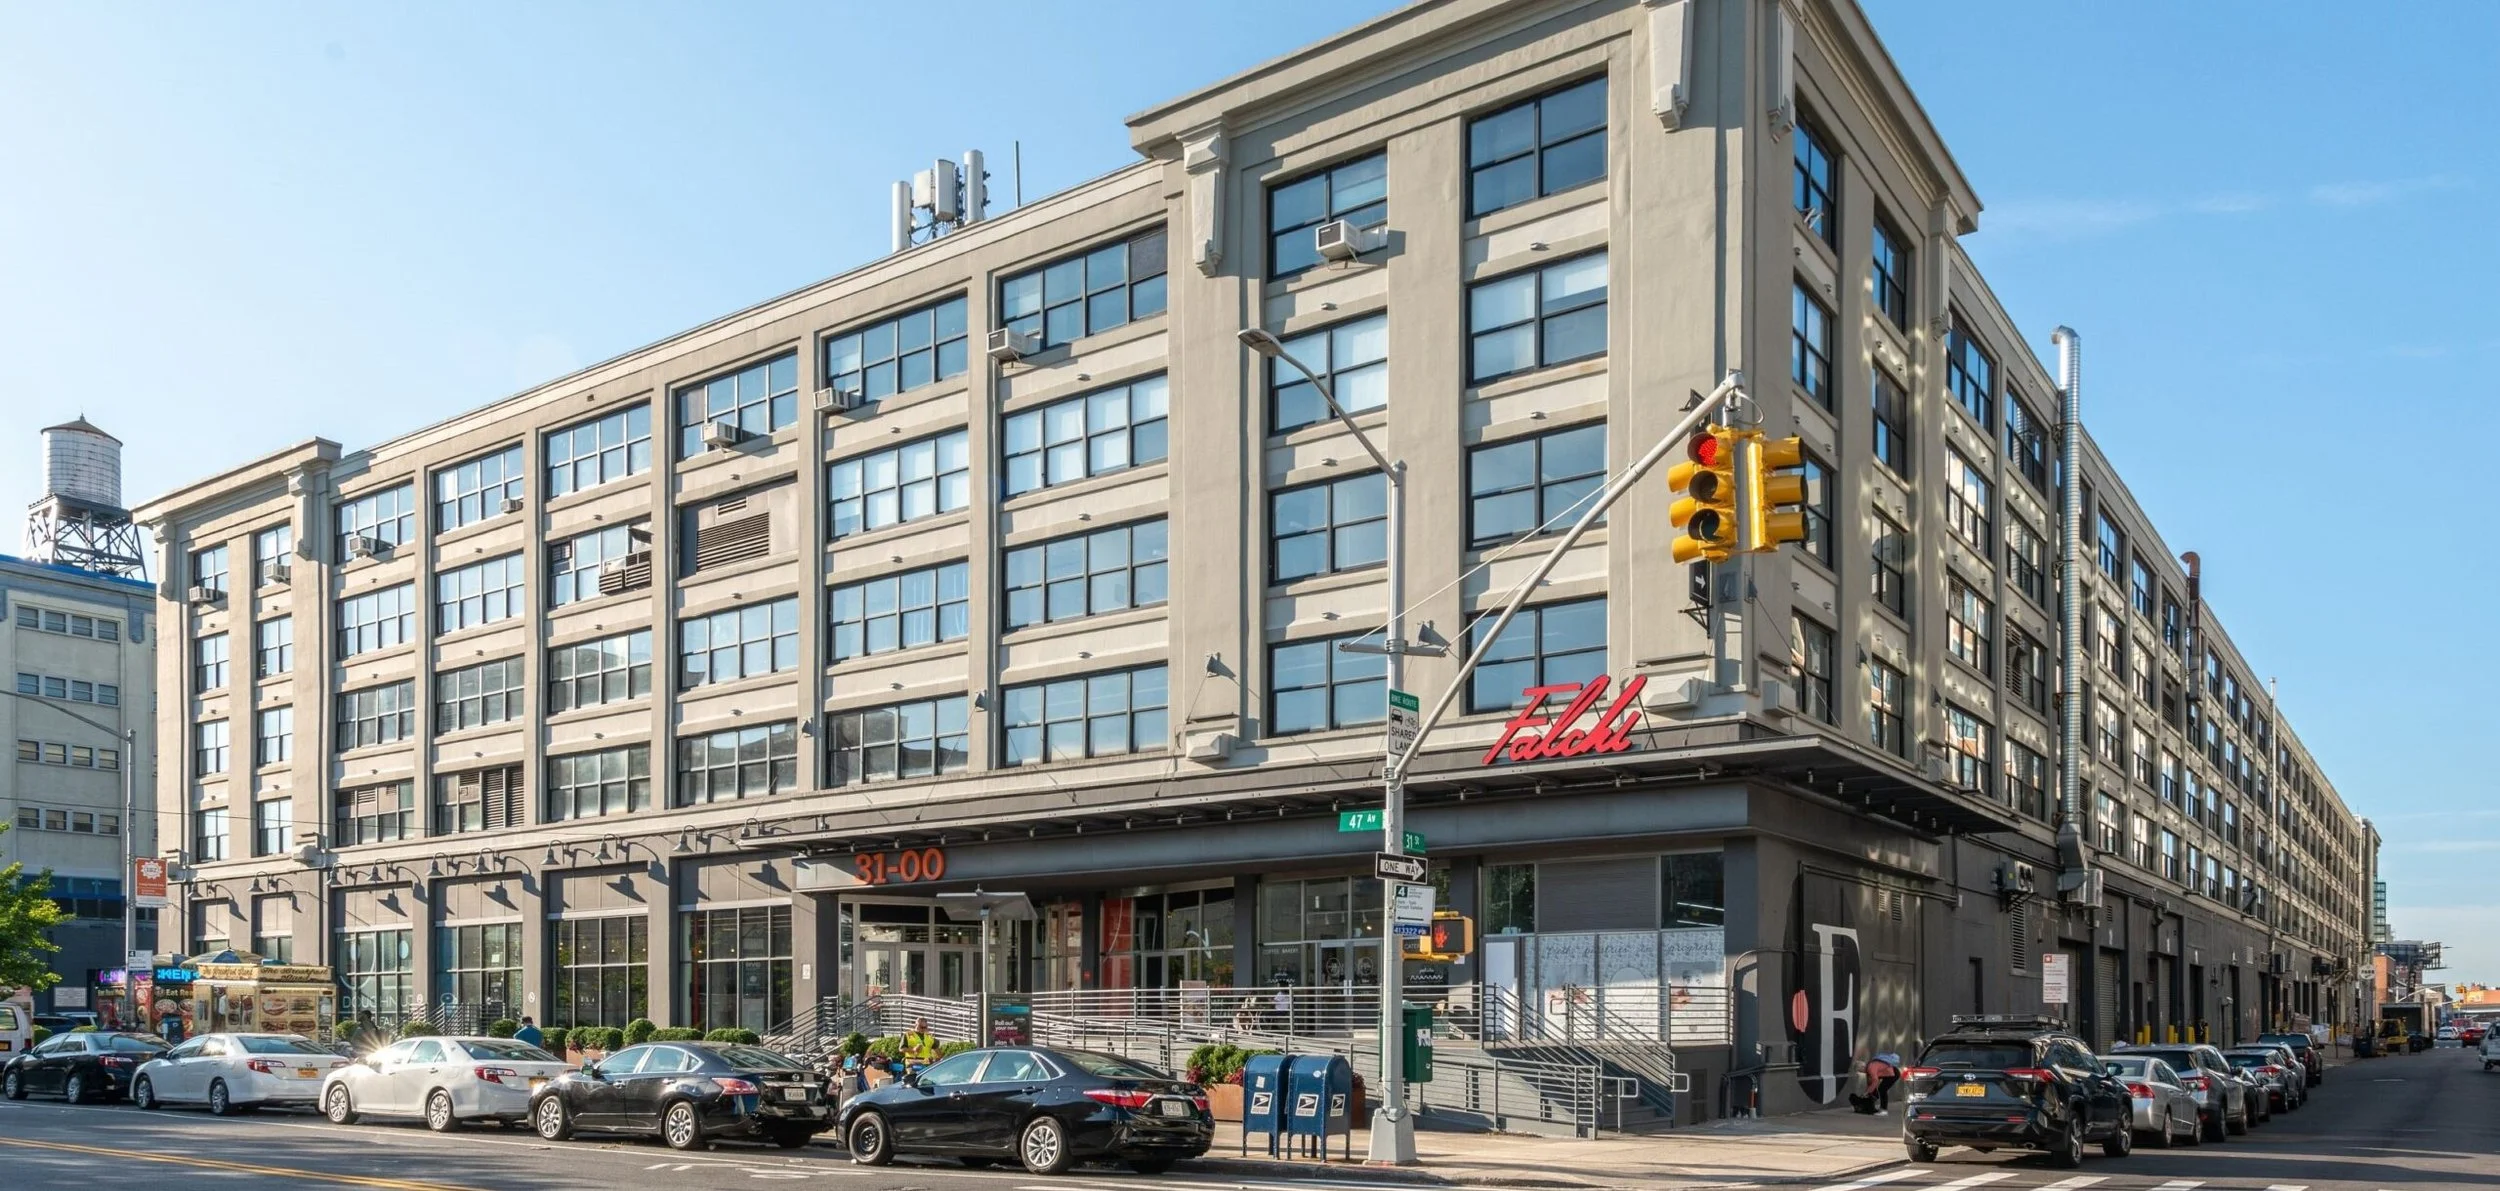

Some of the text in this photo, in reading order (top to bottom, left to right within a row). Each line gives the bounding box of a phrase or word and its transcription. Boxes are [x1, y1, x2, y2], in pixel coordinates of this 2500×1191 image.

[1481, 674, 1649, 766] Falchi
[1391, 726, 1417, 741] SHARED
[1349, 814, 1363, 829] 47
[1405, 834, 1413, 849] 31
[854, 847, 945, 884] 31-00
[1384, 861, 1421, 875] ONE WAY
[1397, 886, 1406, 897] 4
